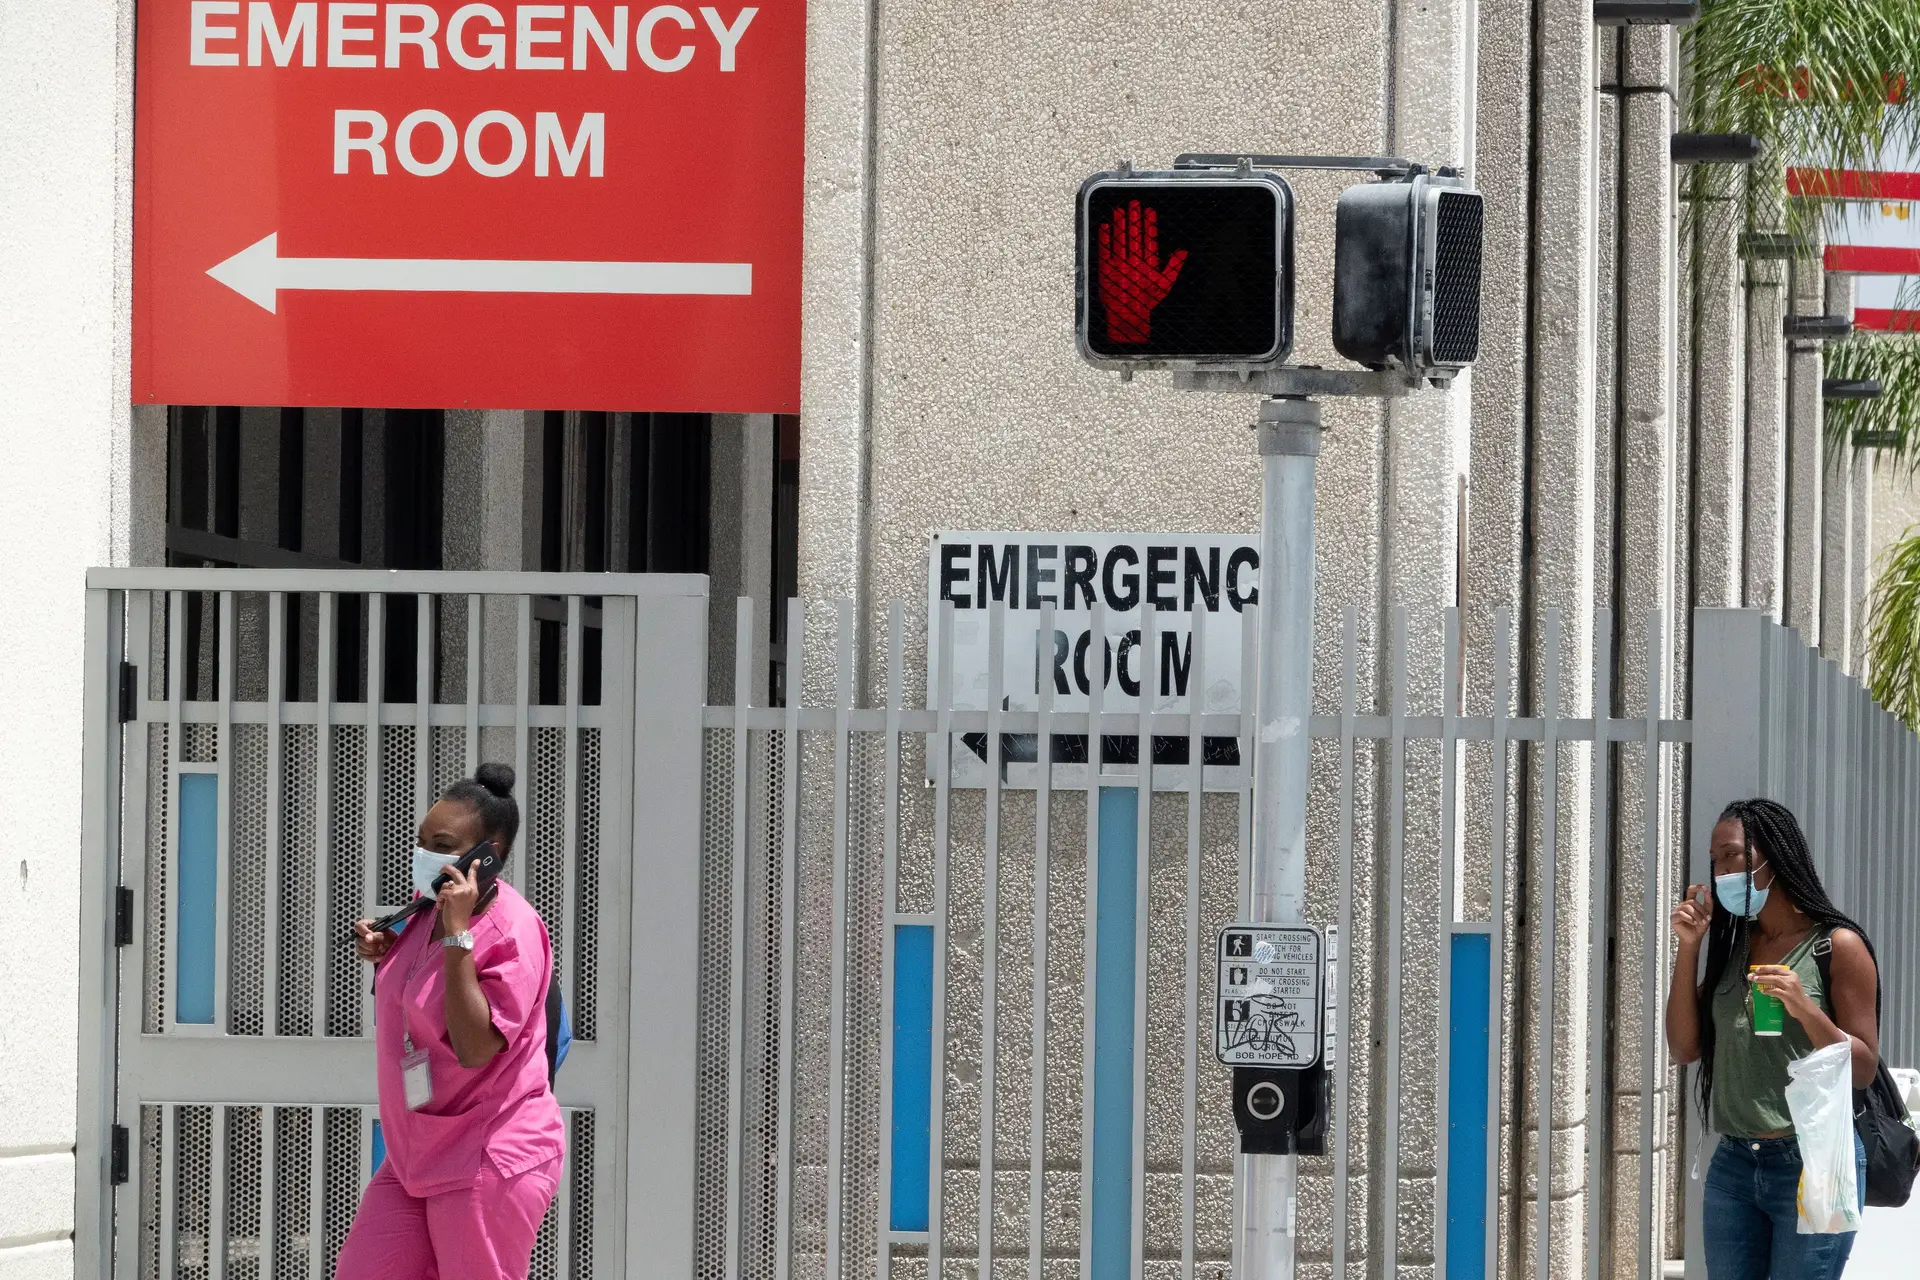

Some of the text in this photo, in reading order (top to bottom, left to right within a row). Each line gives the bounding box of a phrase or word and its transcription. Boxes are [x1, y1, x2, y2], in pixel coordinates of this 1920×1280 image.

[190, 0, 759, 73] EMERGENCY
[333, 108, 605, 178] ROOM
[940, 544, 1260, 613] EMERGENC
[1256, 933, 1311, 942] START CROSSING
[1283, 953, 1313, 961] VEHICLES
[1259, 967, 1306, 976] DO NOT START
[1278, 978, 1310, 986] CROSSING
[1267, 1035, 1293, 1043] UTTON
[1236, 1052, 1255, 1060] BOB
[1259, 1052, 1283, 1060] HOPE
